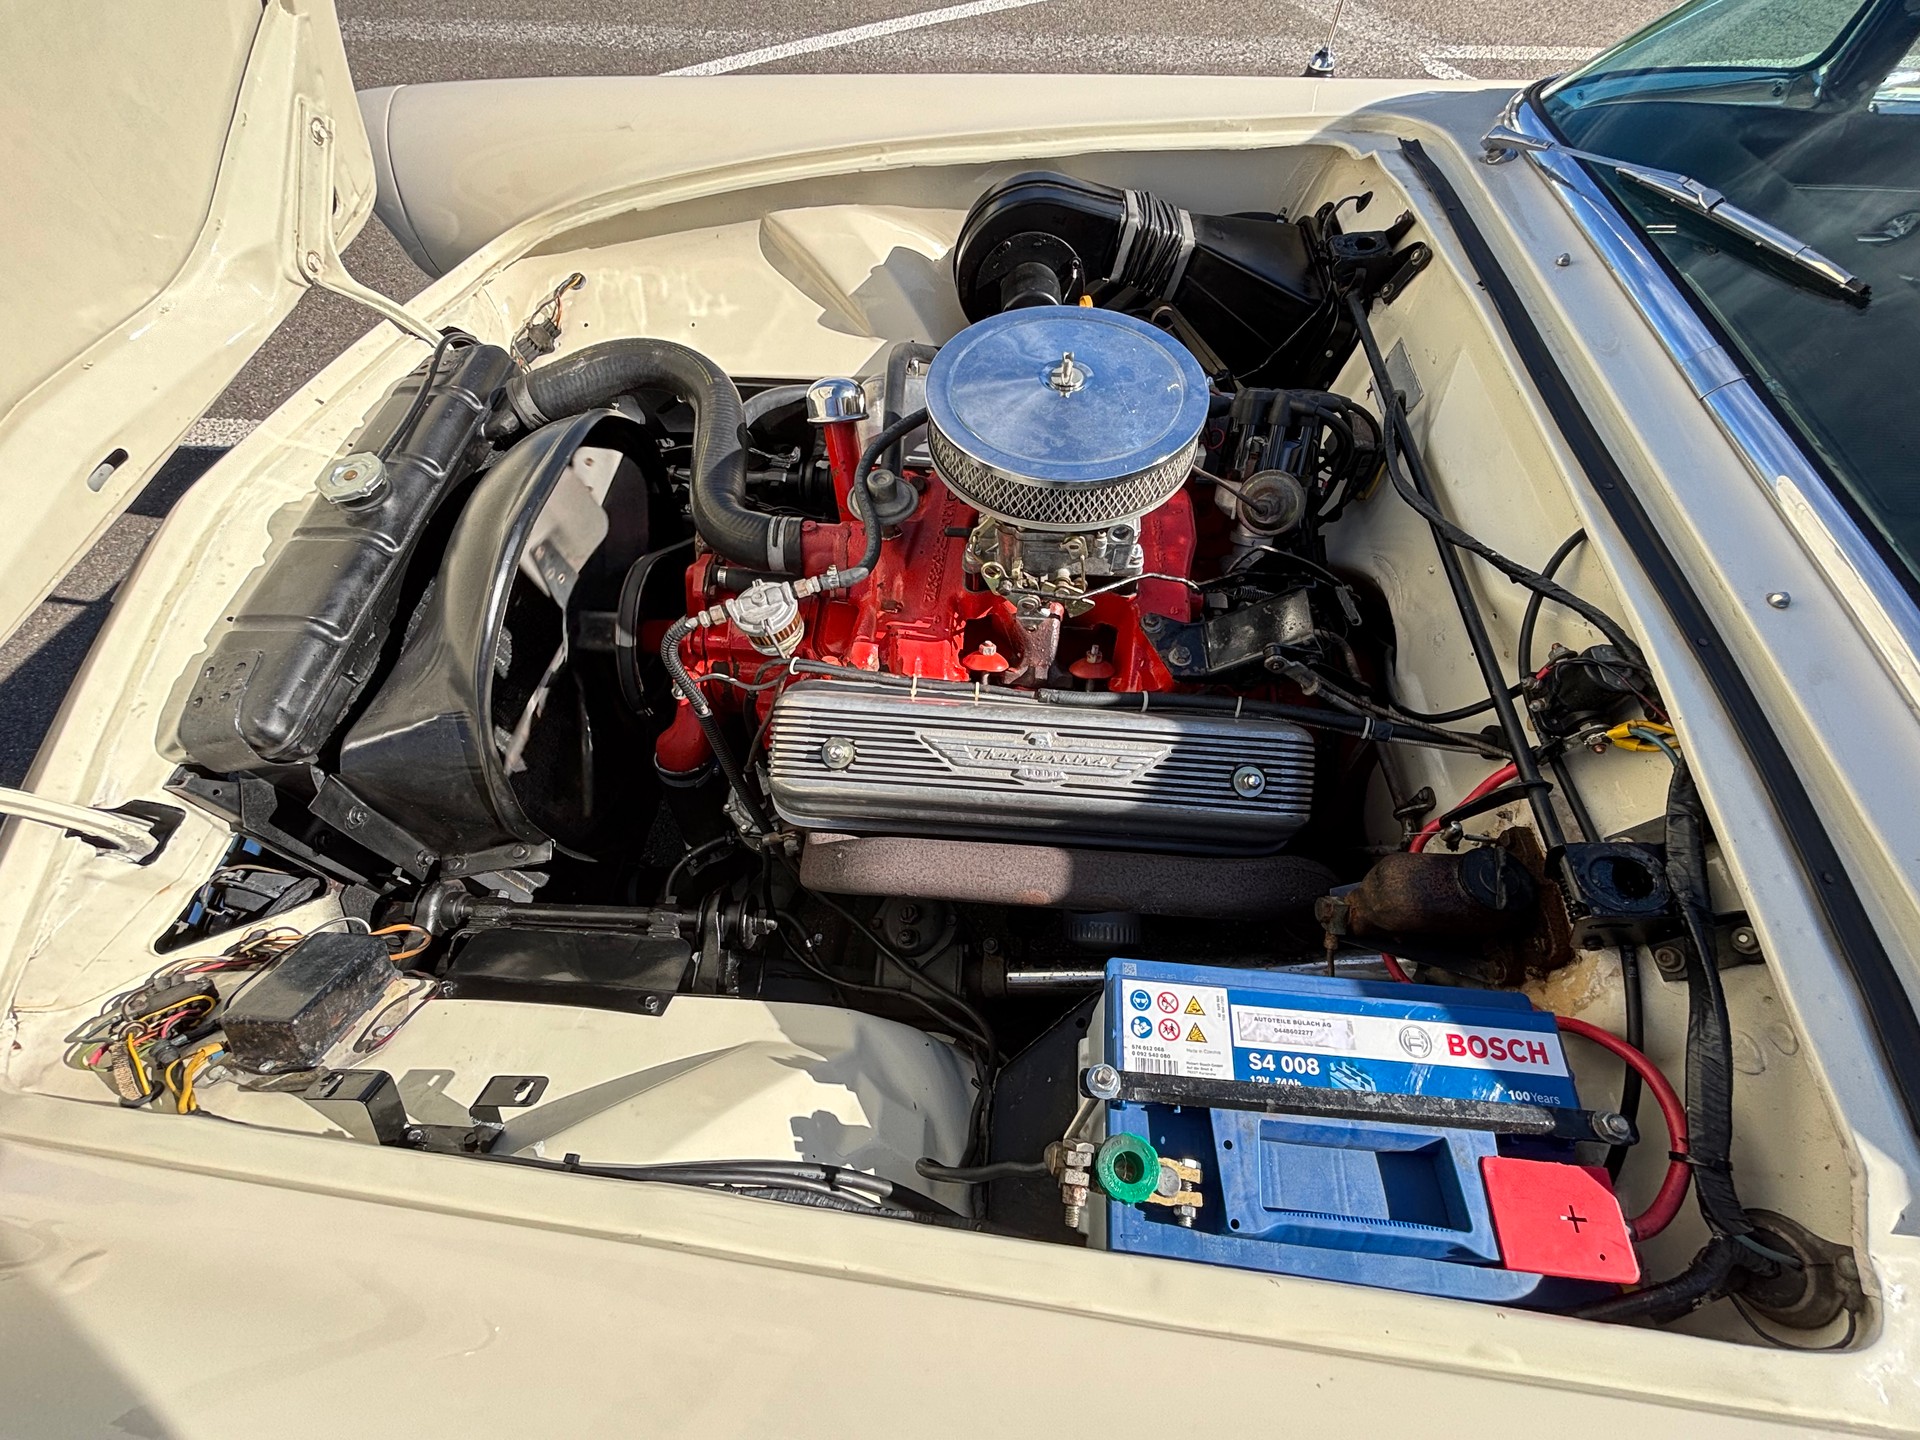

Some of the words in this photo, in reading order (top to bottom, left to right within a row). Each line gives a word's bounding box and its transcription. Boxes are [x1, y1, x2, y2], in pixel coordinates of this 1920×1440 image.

[1253, 1016, 1291, 1025] AUTOTEILE
[1446, 1033, 1550, 1065] BOSCH
[1248, 1052, 1276, 1072] S4
[1280, 1055, 1320, 1076] 008
[1508, 1089, 1531, 1102] 100
[1530, 1092, 1561, 1105] Years
